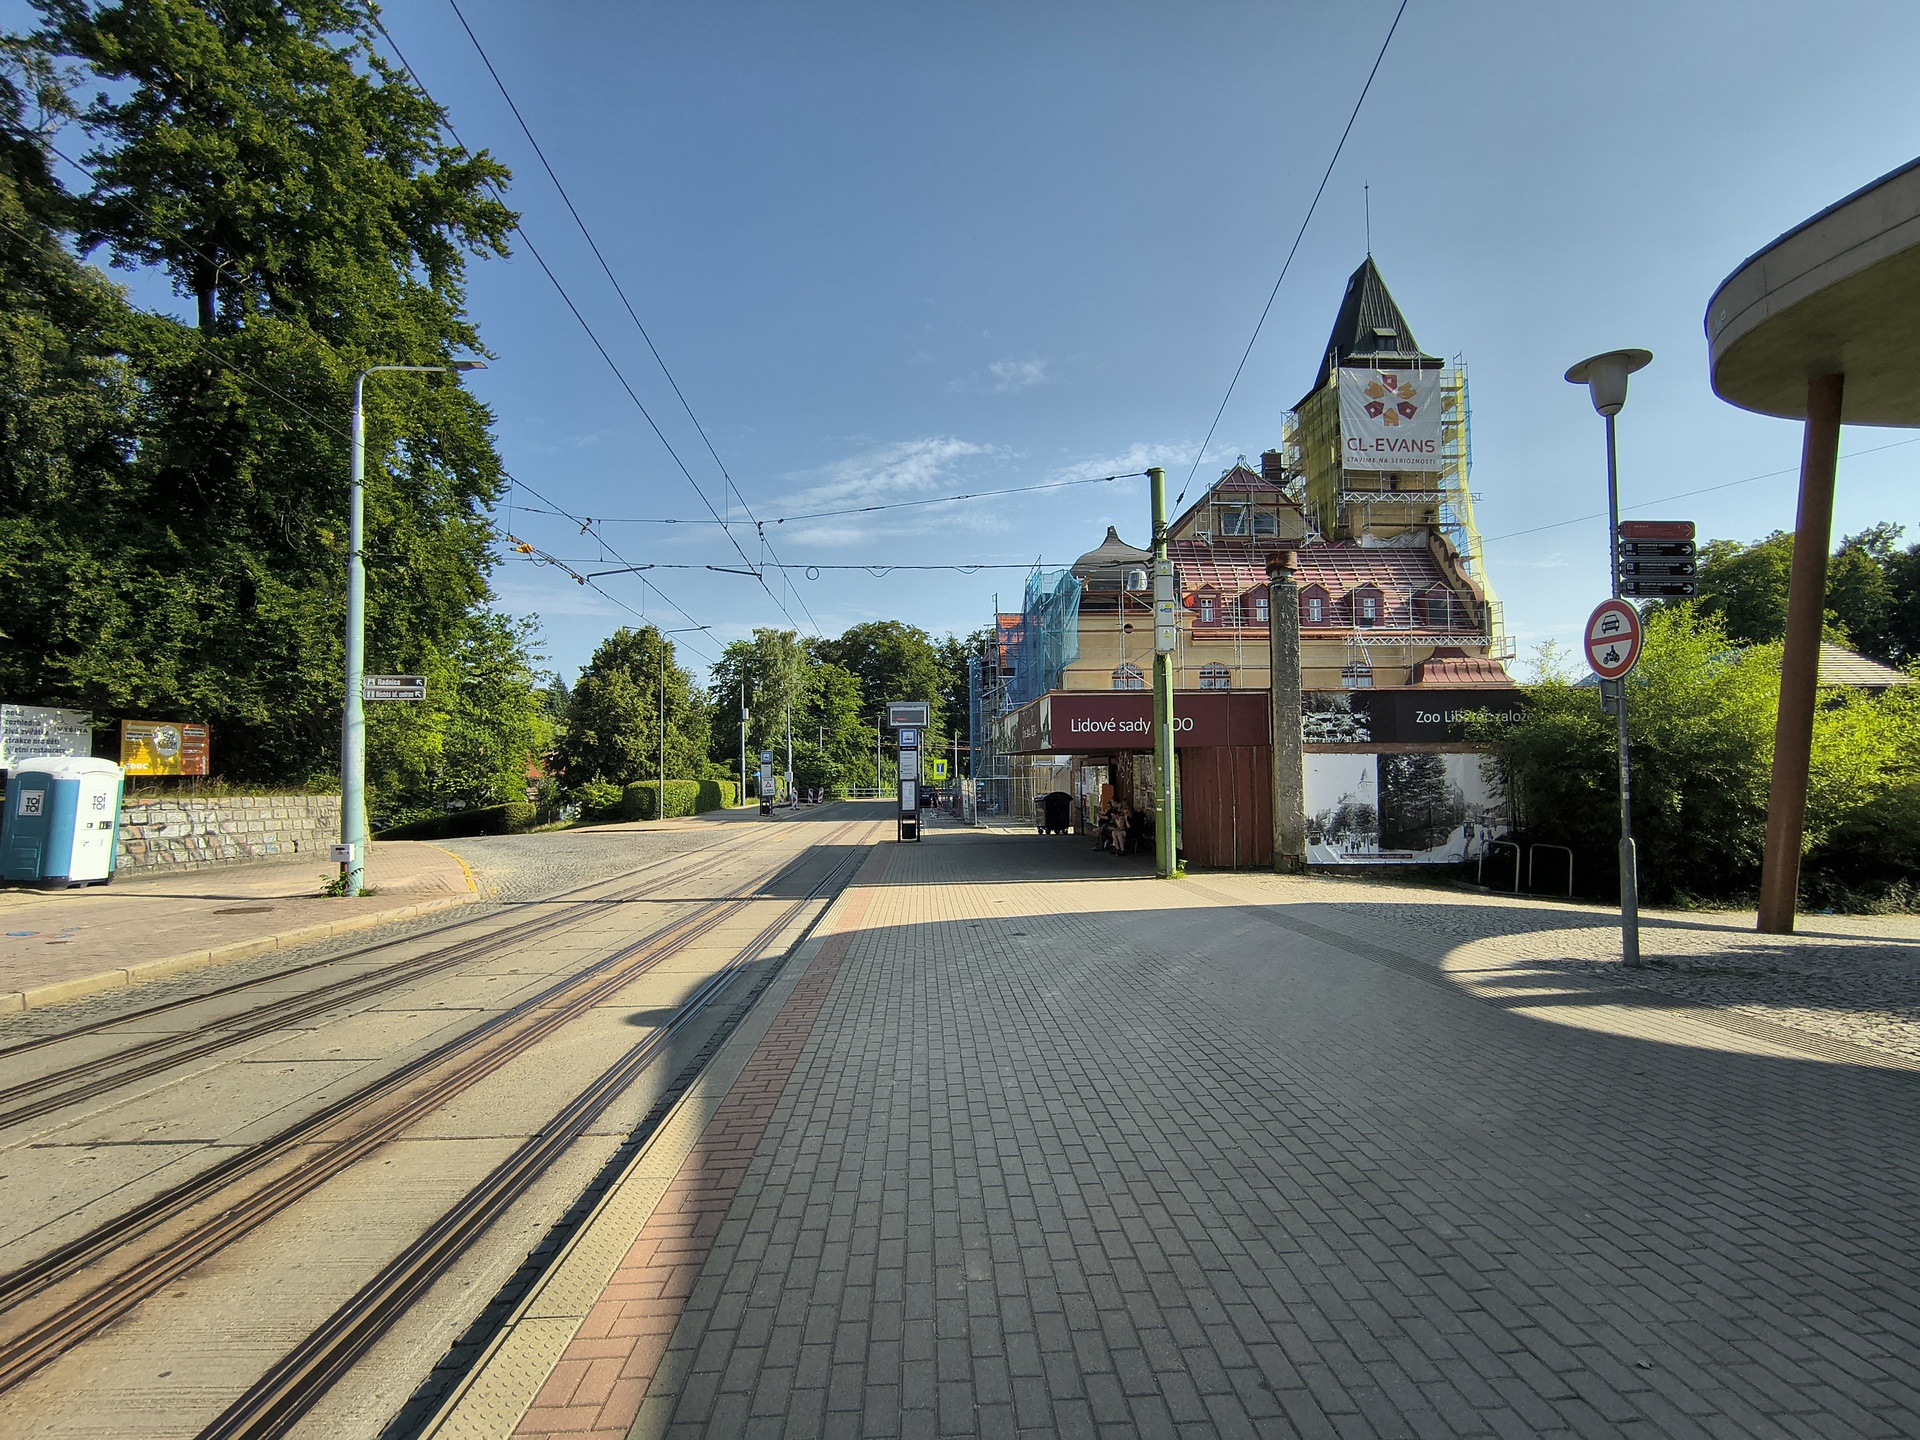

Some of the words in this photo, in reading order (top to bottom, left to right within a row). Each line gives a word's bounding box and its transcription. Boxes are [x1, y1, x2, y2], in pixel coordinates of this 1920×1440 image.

[1347, 438, 1435, 453] CL-EVANS
[1415, 710, 1441, 723] Zoo
[1071, 717, 1116, 733] Lidové
[1118, 717, 1151, 734] sady
